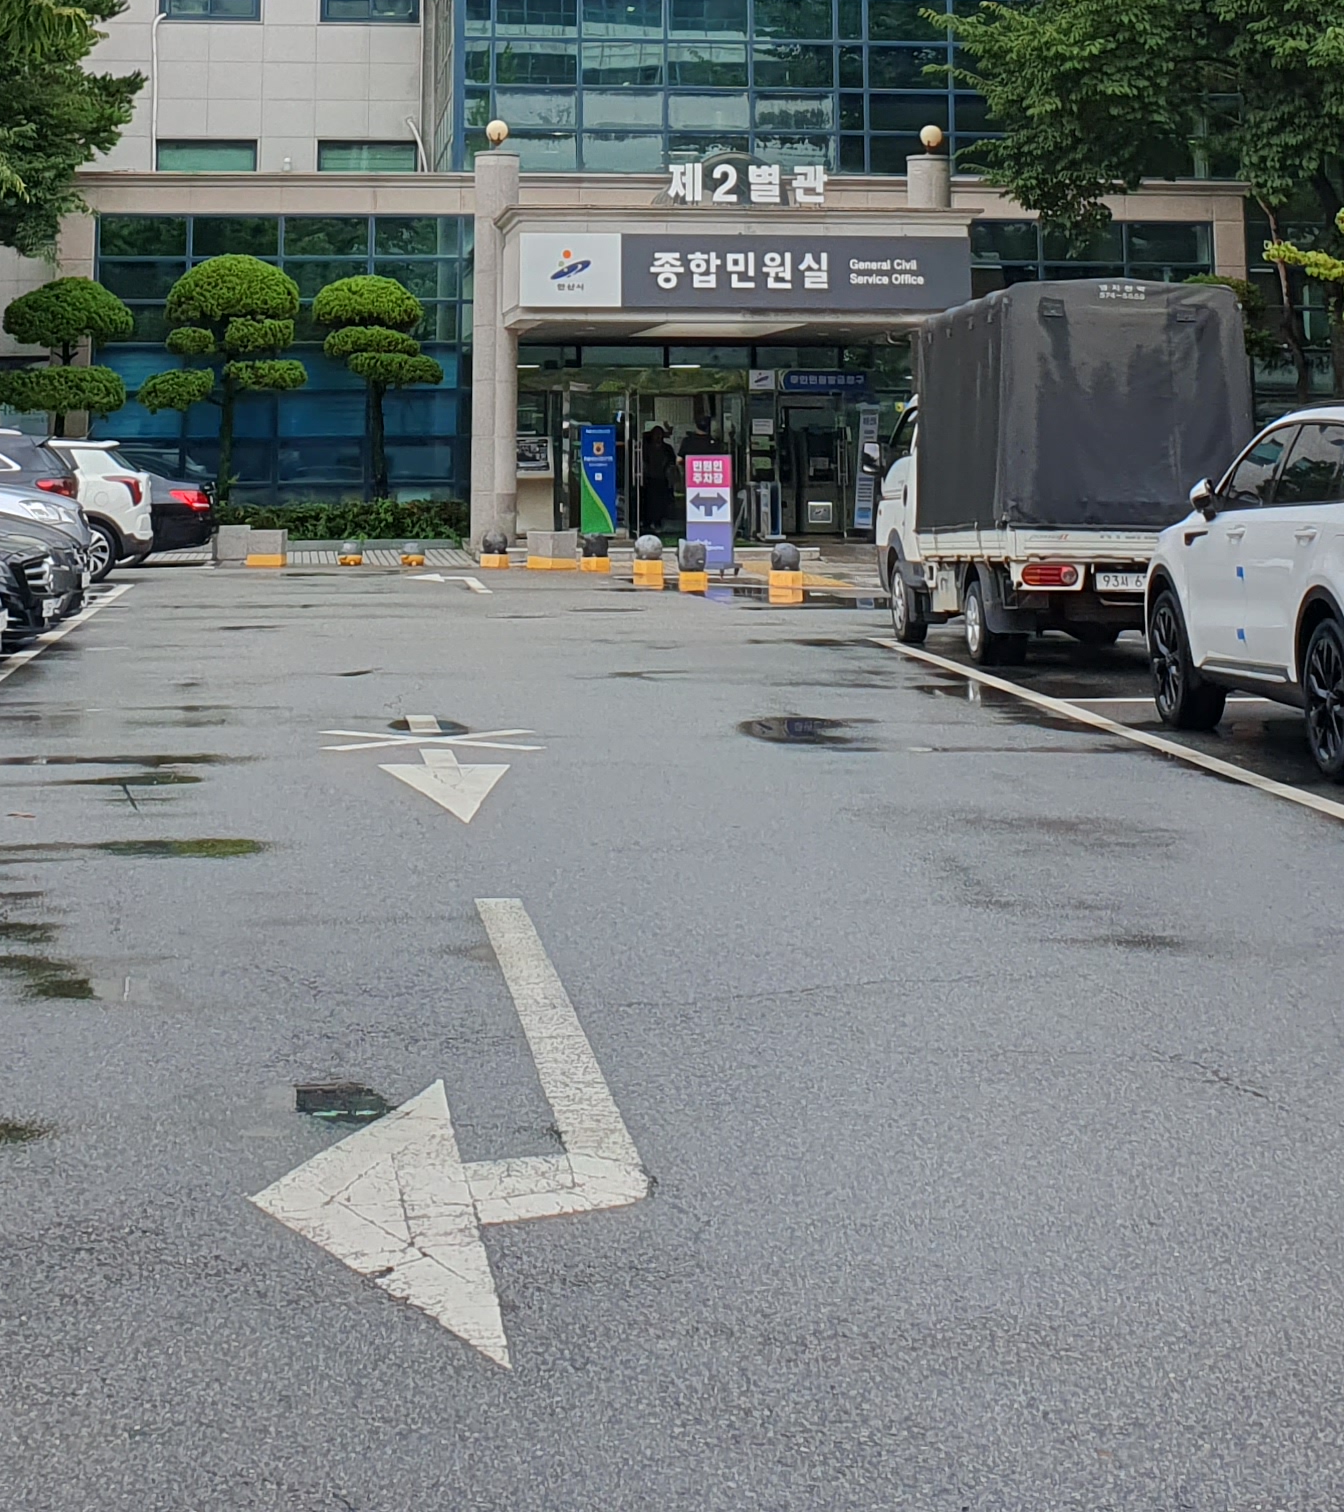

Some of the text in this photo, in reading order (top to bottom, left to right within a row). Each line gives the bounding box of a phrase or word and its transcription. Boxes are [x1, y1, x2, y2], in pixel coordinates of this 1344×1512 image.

[667, 162, 829, 204] 제2별관
[849, 259, 917, 270] General Civil
[649, 252, 830, 290] 종합민원실
[849, 273, 925, 285] Service Office
[693, 473, 723, 484] 주차장
